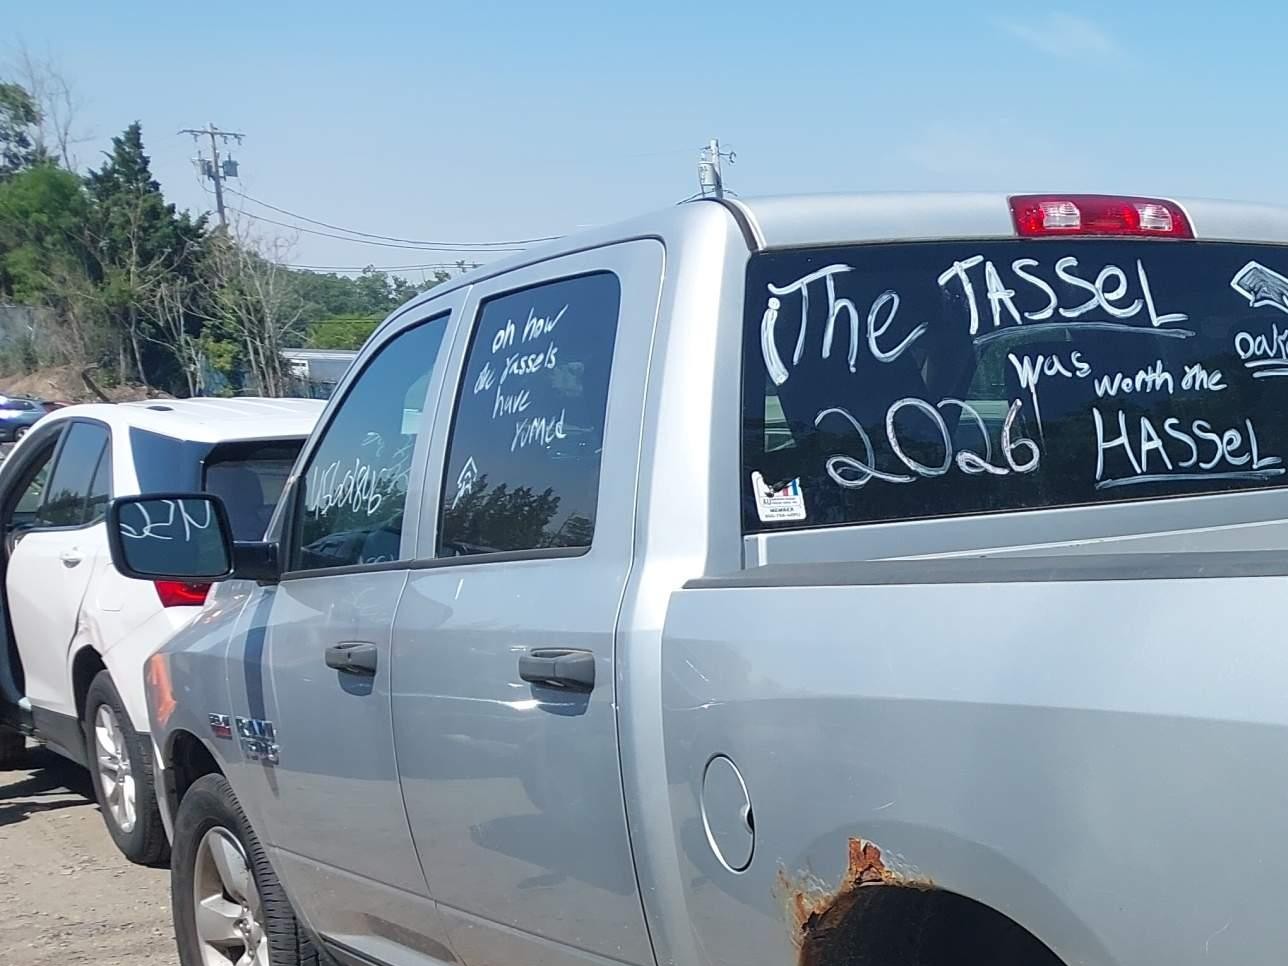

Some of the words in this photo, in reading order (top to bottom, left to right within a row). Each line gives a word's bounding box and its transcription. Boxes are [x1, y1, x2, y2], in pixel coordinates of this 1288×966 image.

[522, 304, 569, 343] how
[1094, 360, 1174, 397] worth
[814, 397, 1040, 489] 2026
